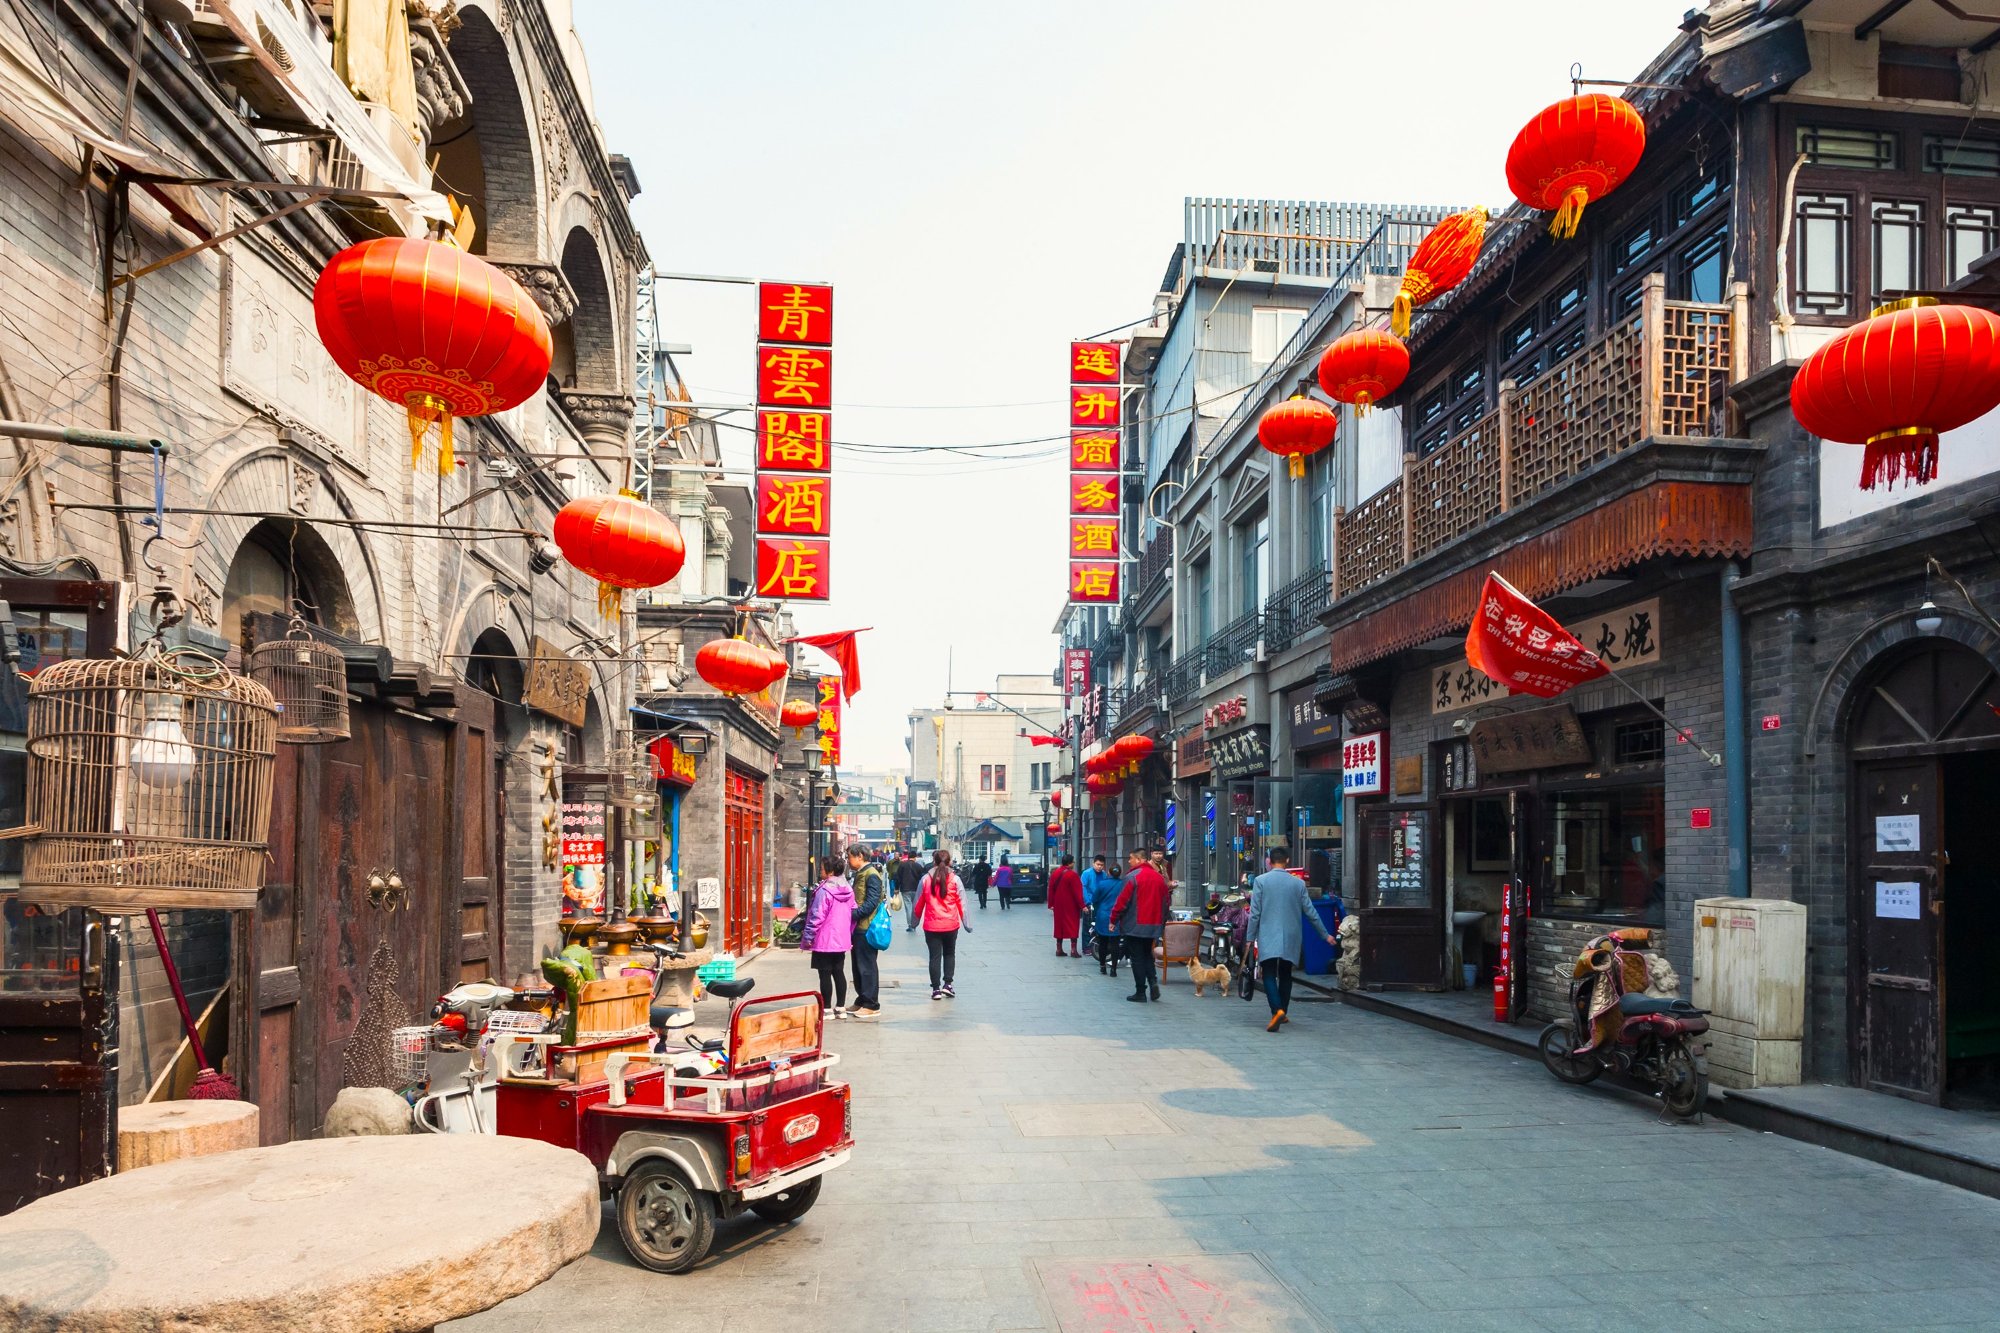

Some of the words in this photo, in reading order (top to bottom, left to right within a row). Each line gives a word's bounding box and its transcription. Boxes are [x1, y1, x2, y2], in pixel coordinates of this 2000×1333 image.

[761, 286, 825, 596] 青雲閣酒店
[1074, 348, 1117, 597] 连升商务酒店
[1222, 768, 1231, 777] Old
[1231, 765, 1248, 776] Beijing
[1248, 762, 1265, 771] shoes
[568, 843, 594, 852] 老北京
